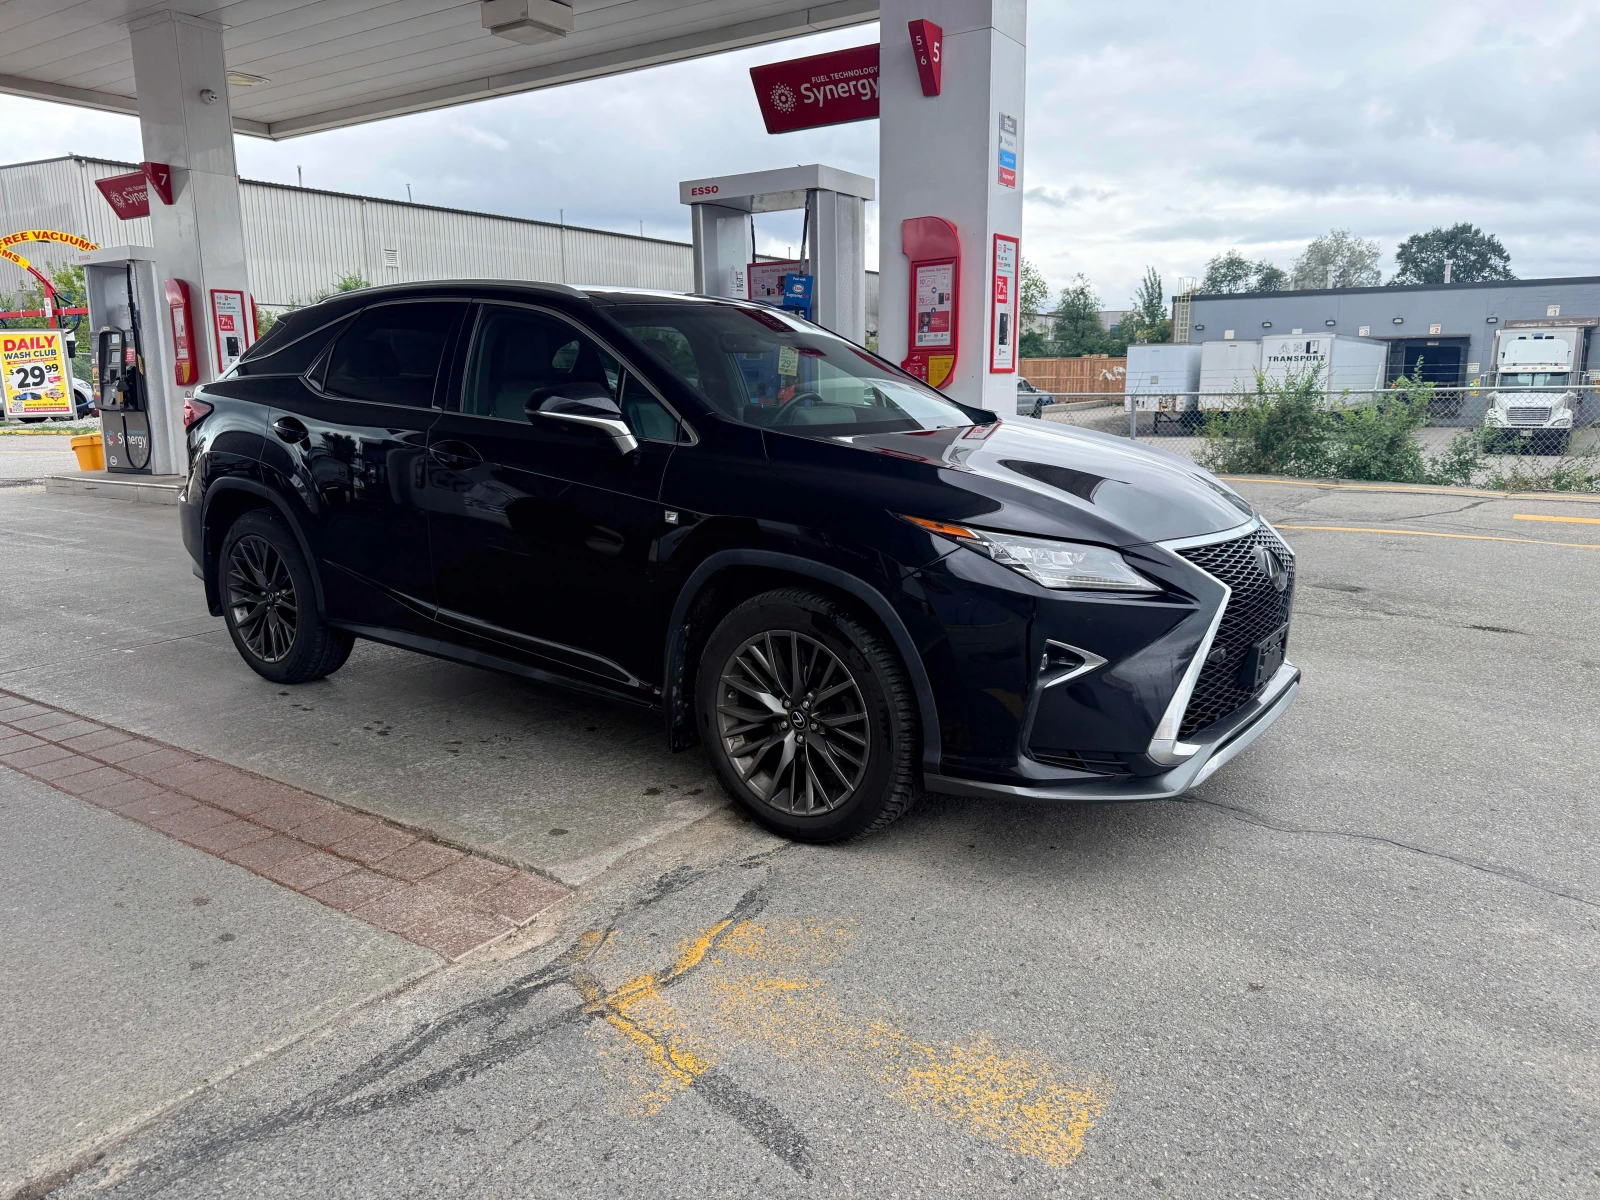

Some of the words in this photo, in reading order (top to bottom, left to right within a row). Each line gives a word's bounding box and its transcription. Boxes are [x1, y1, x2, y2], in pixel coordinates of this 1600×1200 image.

[916, 36, 922, 46] 5
[921, 56, 927, 65] 6
[934, 42, 940, 62] 5
[812, 75, 830, 84] FUEL
[830, 66, 878, 80] TECHNOLOGY
[158, 173, 168, 186] 7
[692, 184, 718, 196] ESSO
[32, 230, 98, 251] VACUUMS
[0, 250, 20, 262] MS
[4, 336, 56, 352] DAILY
[4, 351, 31, 360] WASH
[34, 349, 57, 358] CLUB
